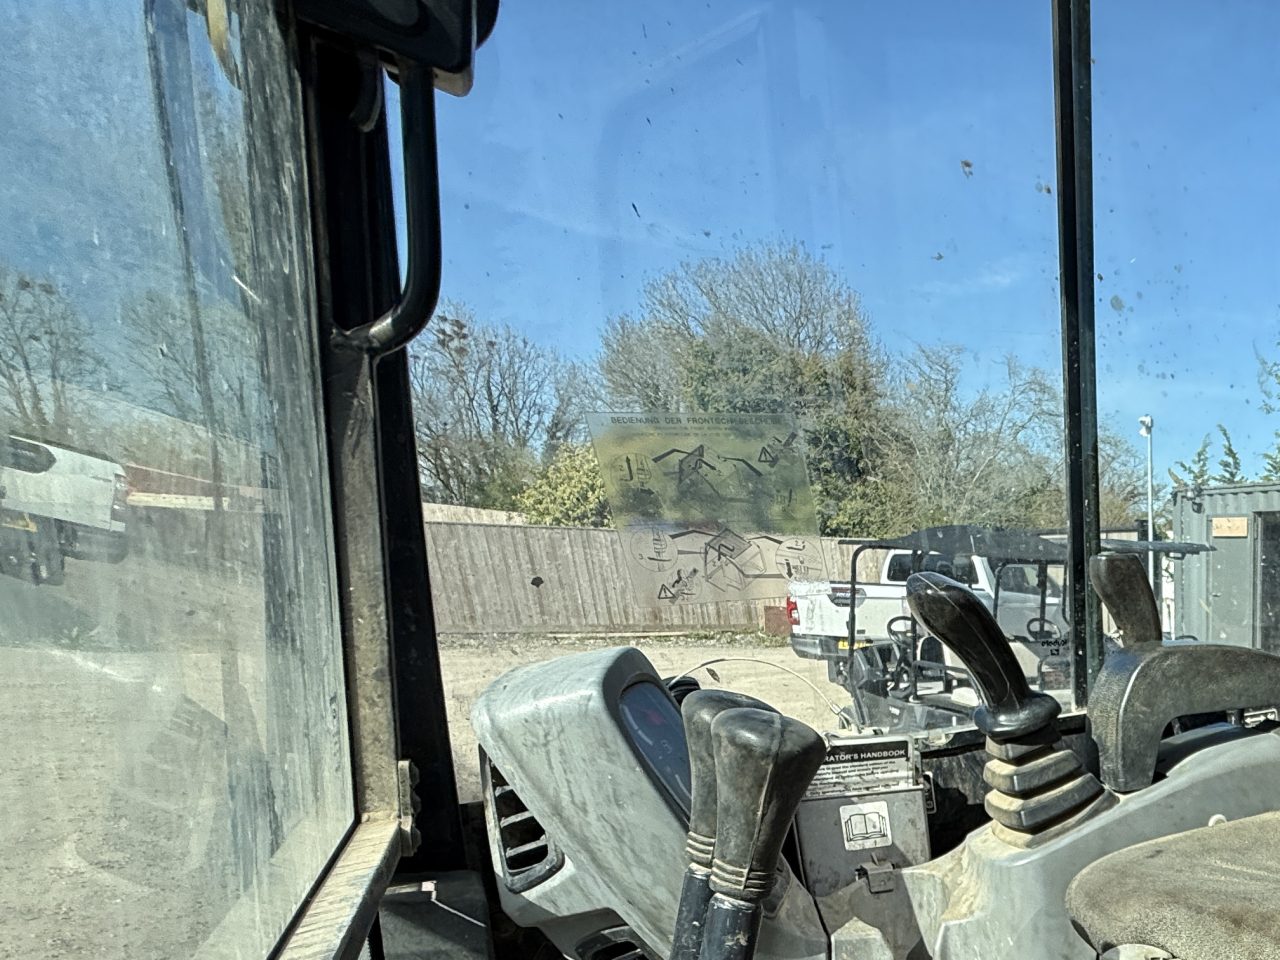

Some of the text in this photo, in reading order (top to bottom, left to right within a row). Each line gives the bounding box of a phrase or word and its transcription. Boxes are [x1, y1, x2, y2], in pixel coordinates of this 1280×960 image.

[611, 416, 660, 424] BEDIENUNG
[664, 416, 682, 424] DER
[825, 749, 905, 762] RATOR'S HANDBOOK
